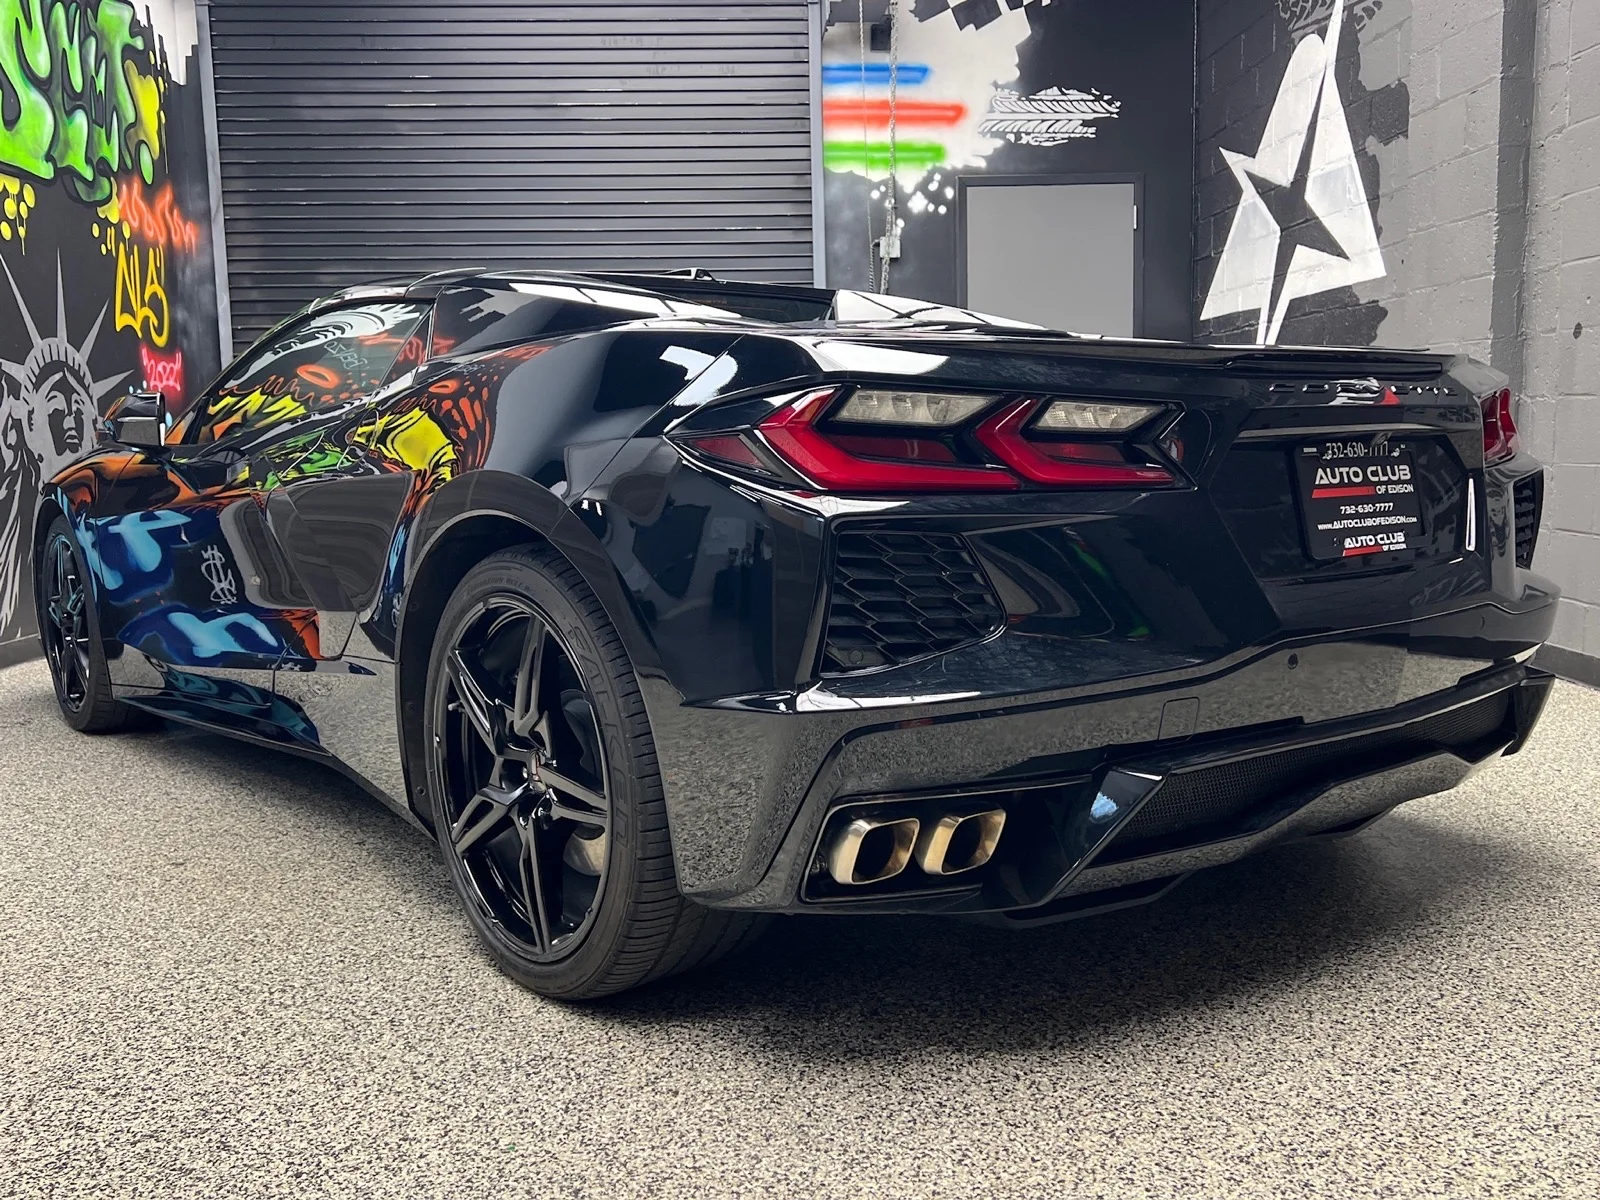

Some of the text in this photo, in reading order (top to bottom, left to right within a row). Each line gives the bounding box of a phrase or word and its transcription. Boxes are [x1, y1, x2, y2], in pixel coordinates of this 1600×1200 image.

[1315, 465, 1411, 485] AUTO CLUB
[1376, 484, 1414, 494] OF EDISON
[1340, 503, 1393, 514] 732-630-7777
[1344, 531, 1405, 548] AUTO CLUB
